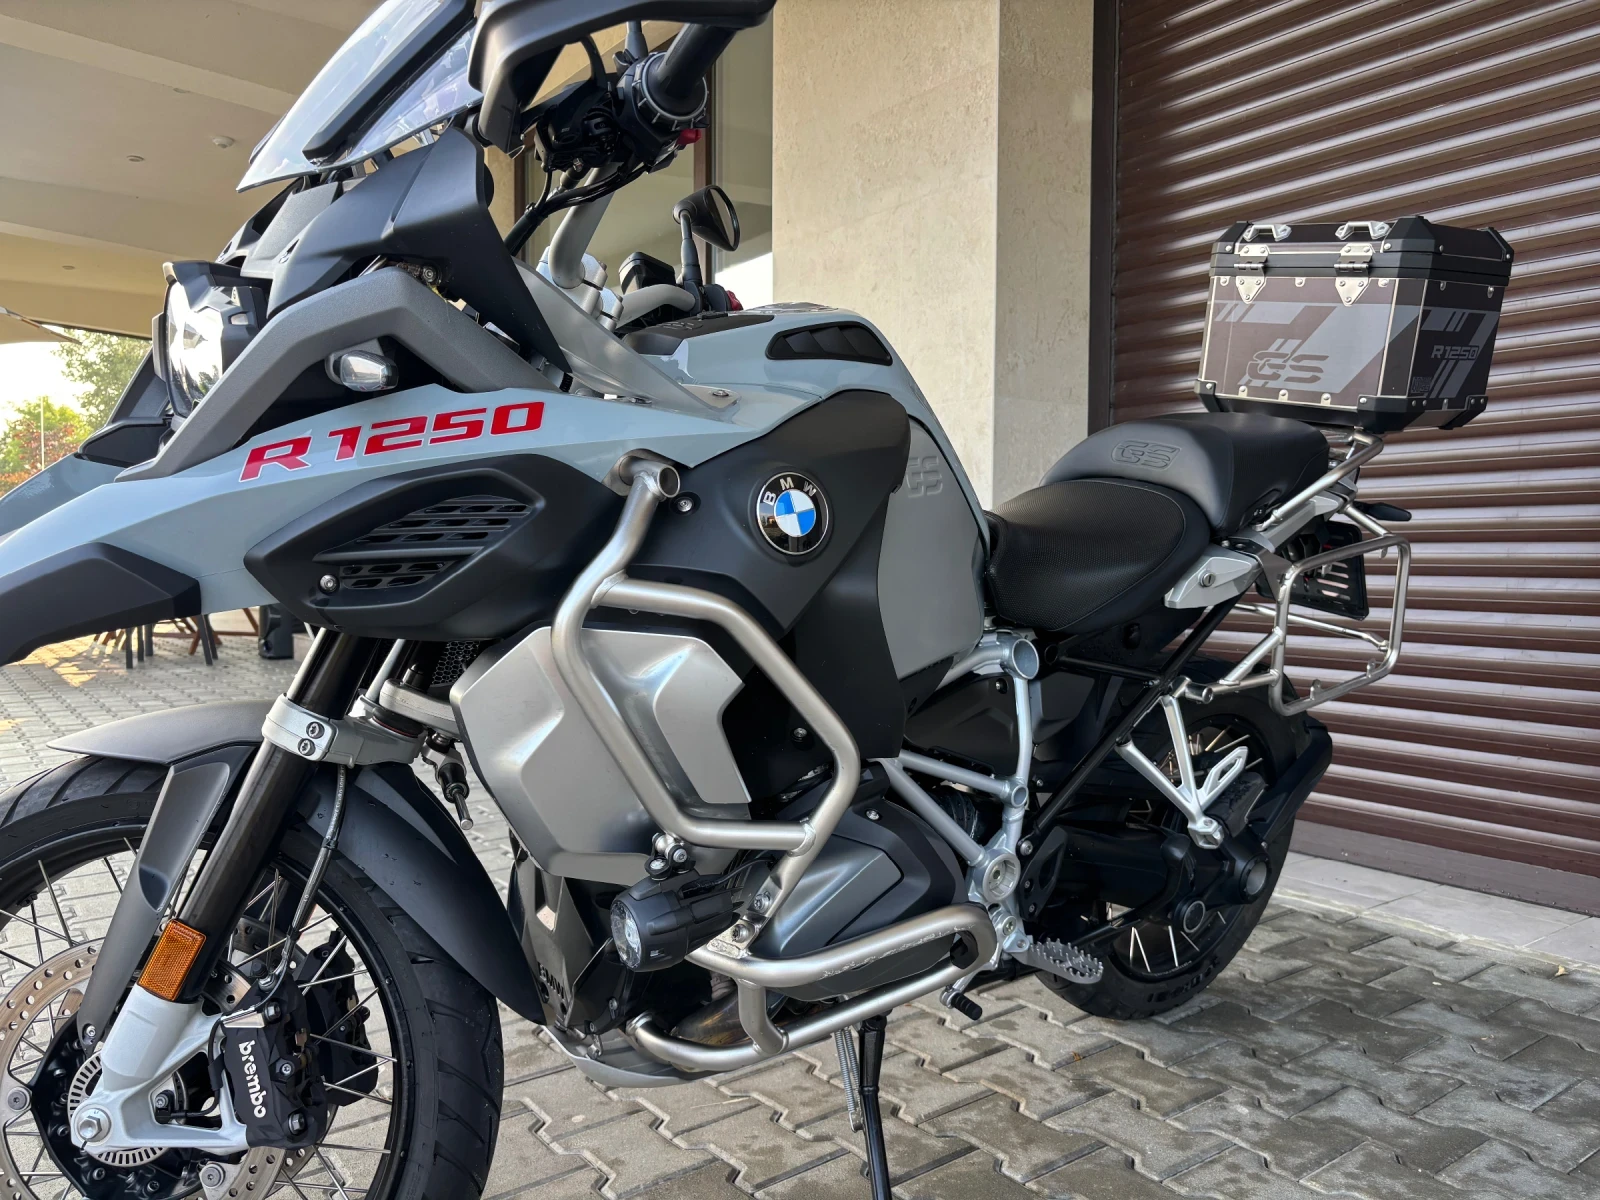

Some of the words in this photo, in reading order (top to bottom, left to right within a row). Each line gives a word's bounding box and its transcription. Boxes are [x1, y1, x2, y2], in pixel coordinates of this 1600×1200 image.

[1247, 350, 1330, 384] GS
[1111, 439, 1181, 471] GS
[762, 475, 817, 507] BMW
[238, 1039, 267, 1118] brembo
